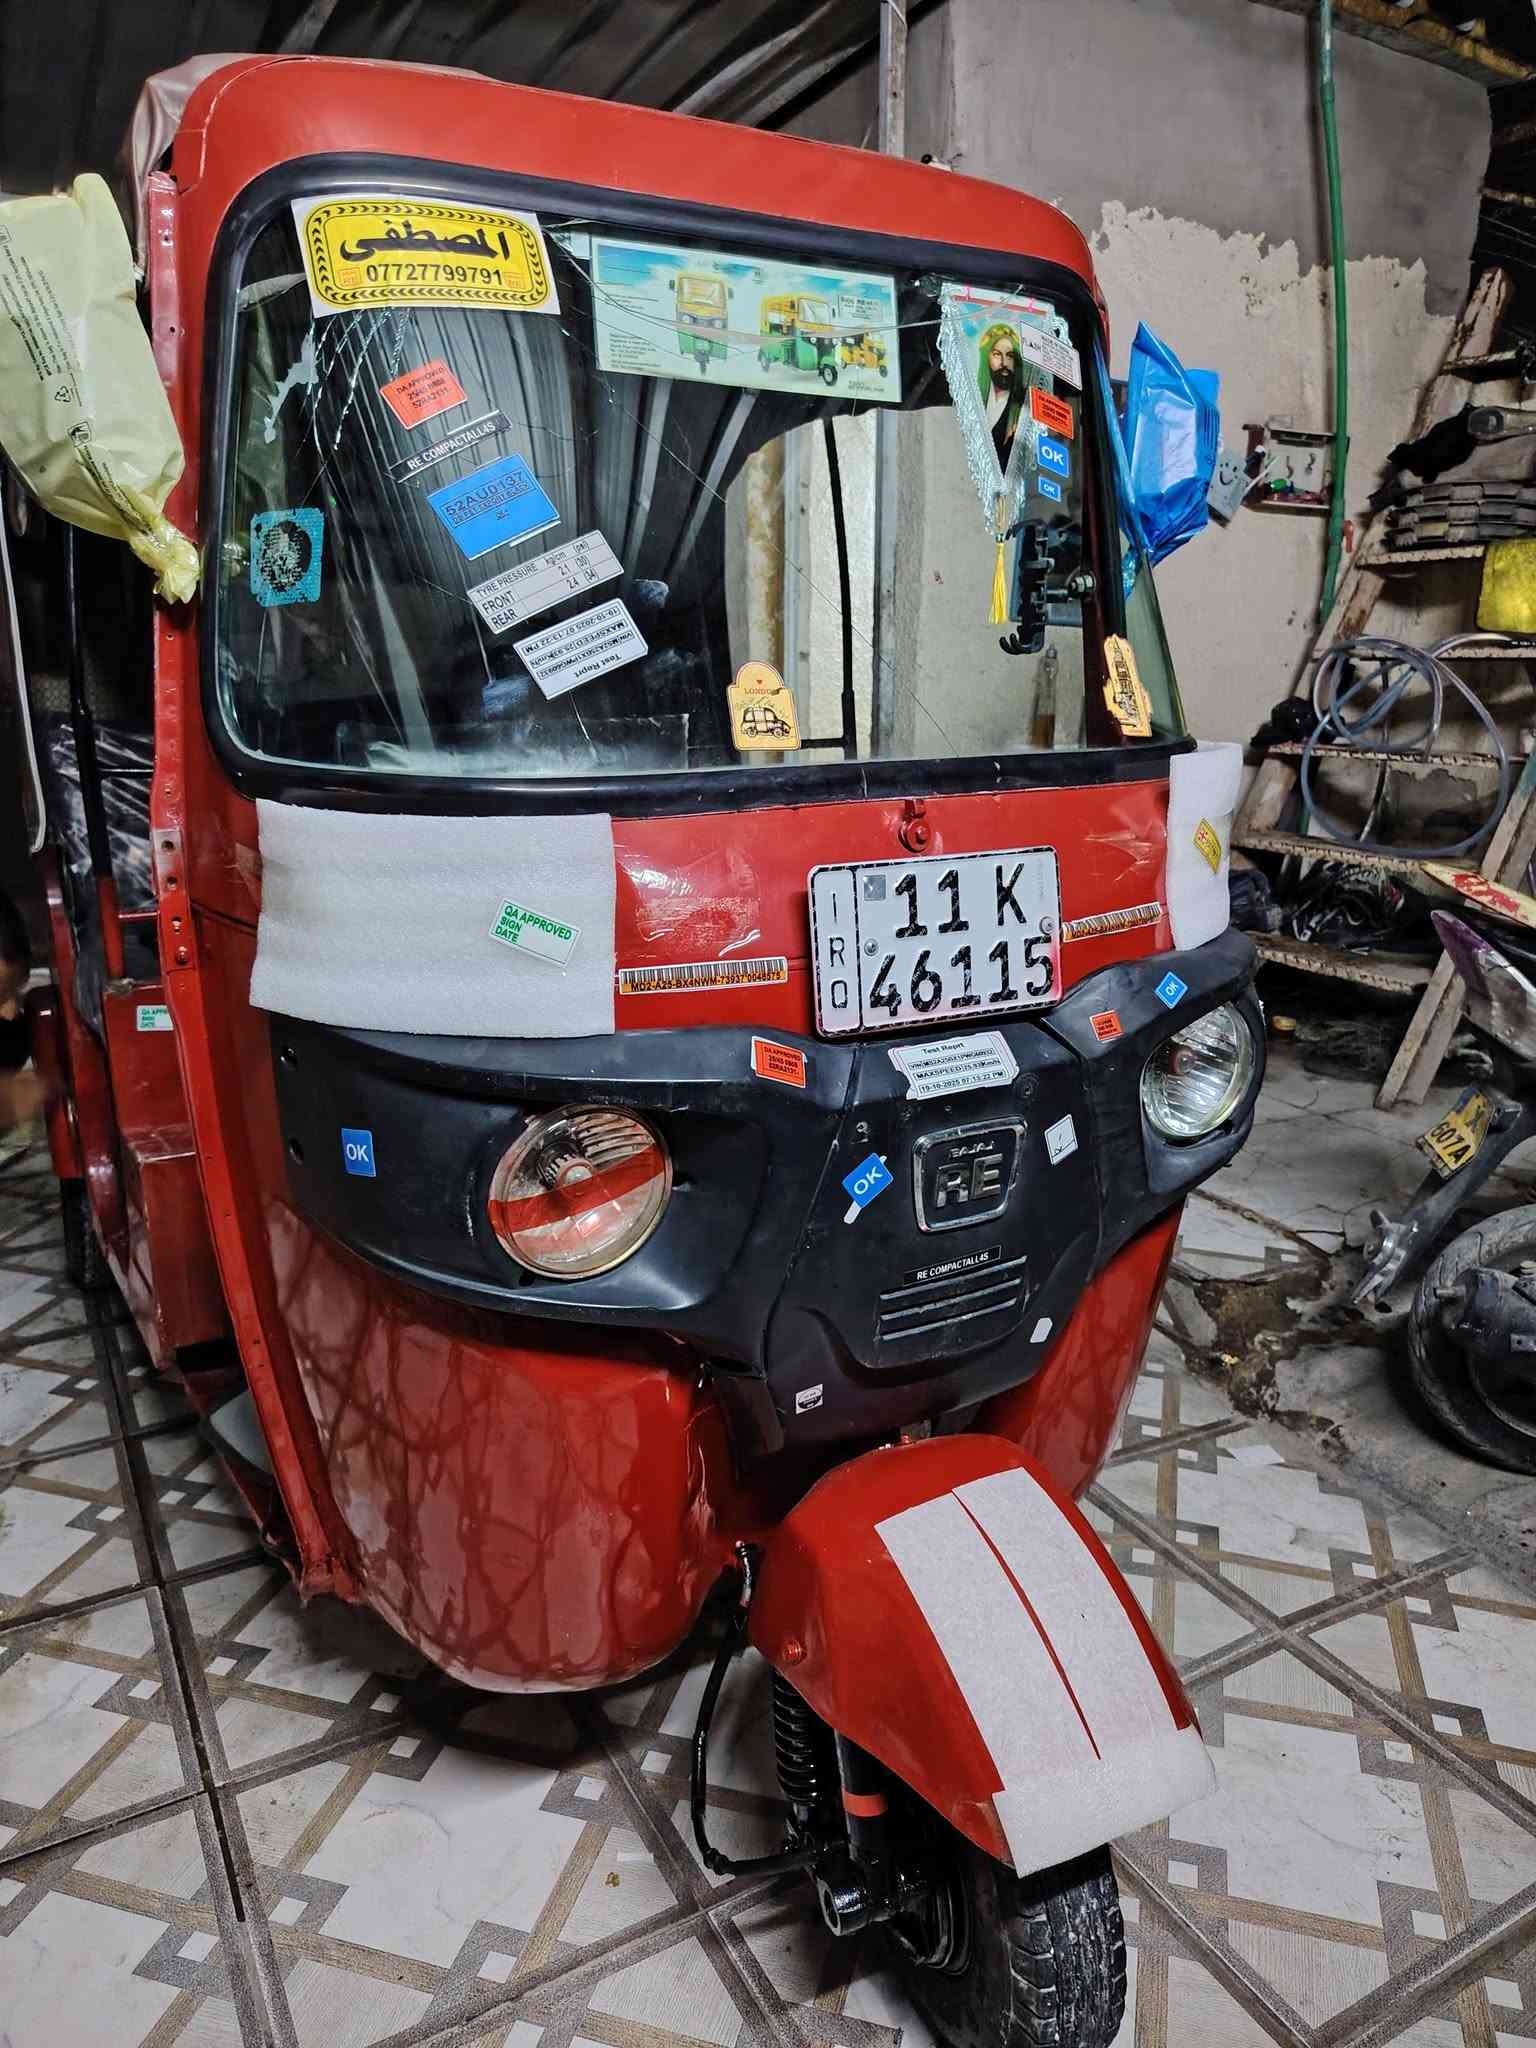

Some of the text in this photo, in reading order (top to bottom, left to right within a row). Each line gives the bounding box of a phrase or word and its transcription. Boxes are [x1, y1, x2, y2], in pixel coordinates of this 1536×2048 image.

[340, 218, 510, 262] المصطفى
[366, 263, 504, 285] 07727799791
[406, 457, 422, 471] RE
[1042, 446, 1064, 465] OK
[1043, 483, 1055, 494] OK
[477, 581, 498, 597] TYRE
[499, 563, 539, 589] PRESSURE
[481, 590, 516, 615] FRONT
[491, 608, 518, 629] REAR
[525, 641, 540, 653] PM
[600, 652, 622, 666] Test
[895, 862, 1027, 939] 11 K
[500, 916, 522, 932] SIGN
[504, 905, 572, 941] QA APPROVED
[495, 926, 519, 943] DATE
[869, 935, 1054, 1017] 46115
[992, 1070, 1004, 1079] PM
[346, 1143, 369, 1162] OK
[853, 1166, 884, 1196] OK
[936, 1152, 1003, 1209] RE
[916, 1269, 928, 1281] RE
